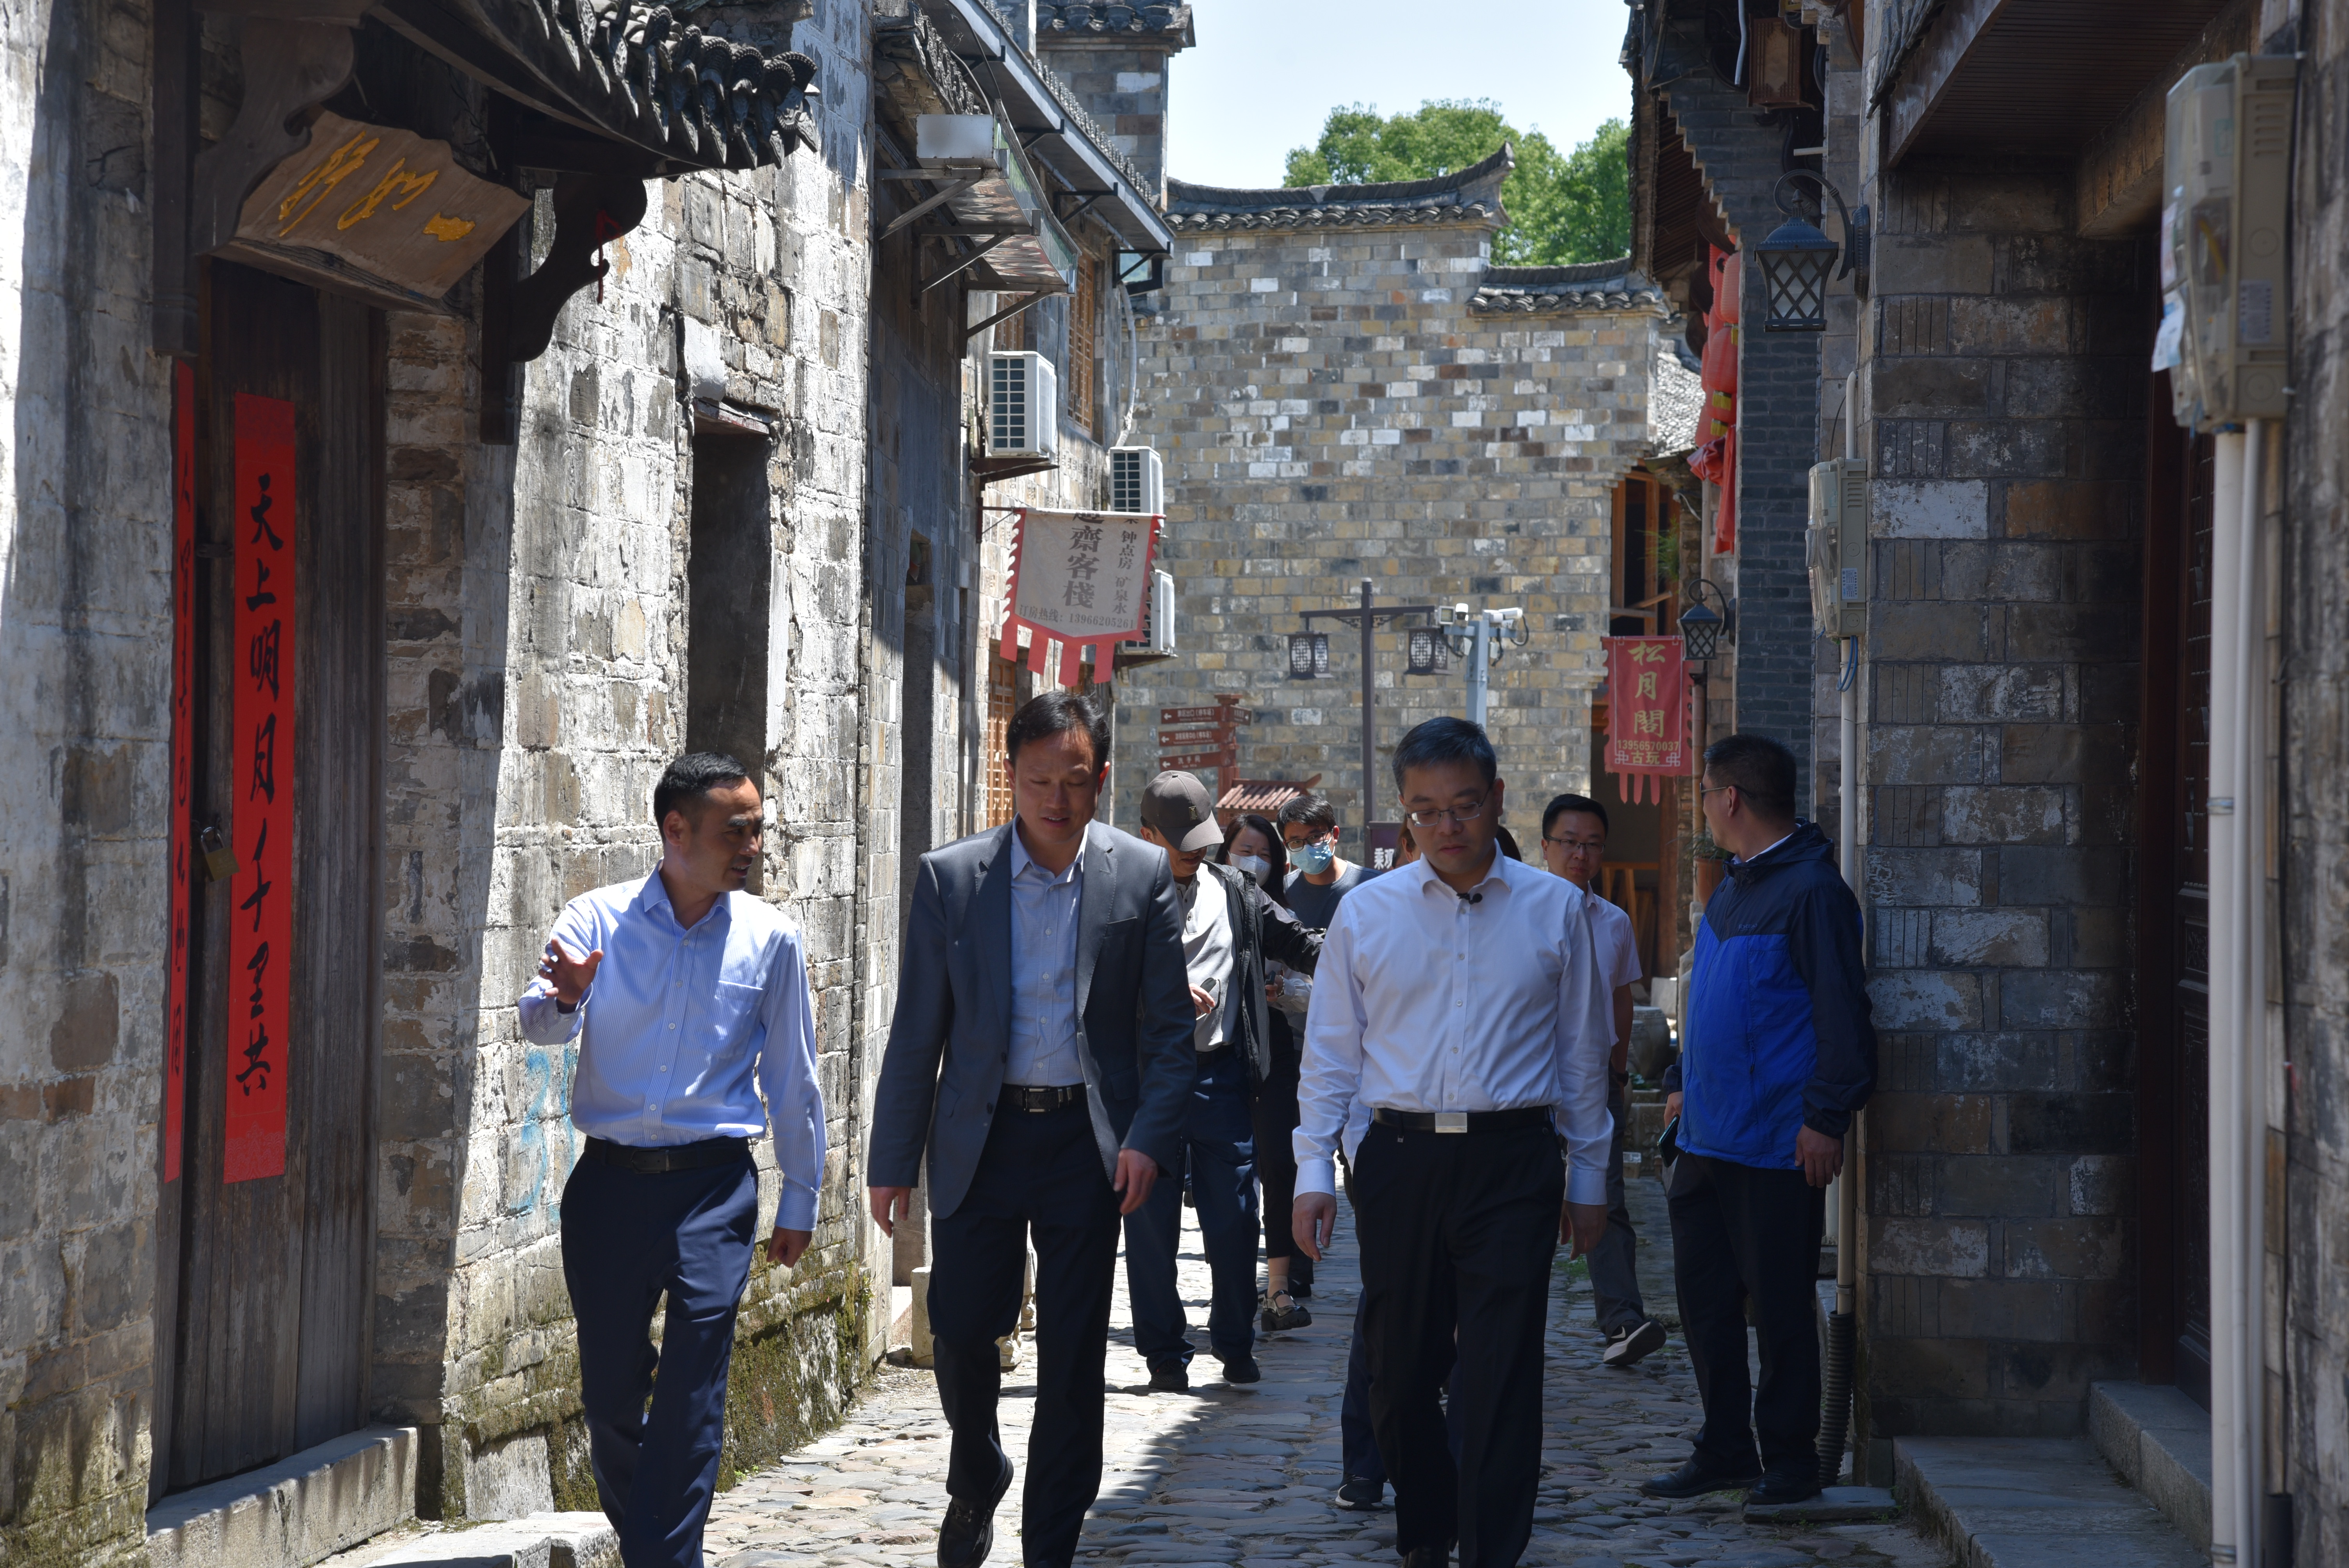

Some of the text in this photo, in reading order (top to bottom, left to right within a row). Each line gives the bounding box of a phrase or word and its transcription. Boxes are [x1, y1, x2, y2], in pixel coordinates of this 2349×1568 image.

[1117, 530, 1137, 570] 钟点房
[1112, 576, 1132, 614] 矿泉水
[1617, 740, 1679, 751] 13956570037
[1631, 750, 1660, 764] 古玩
[236, 472, 284, 1096] 天上明月千里共
